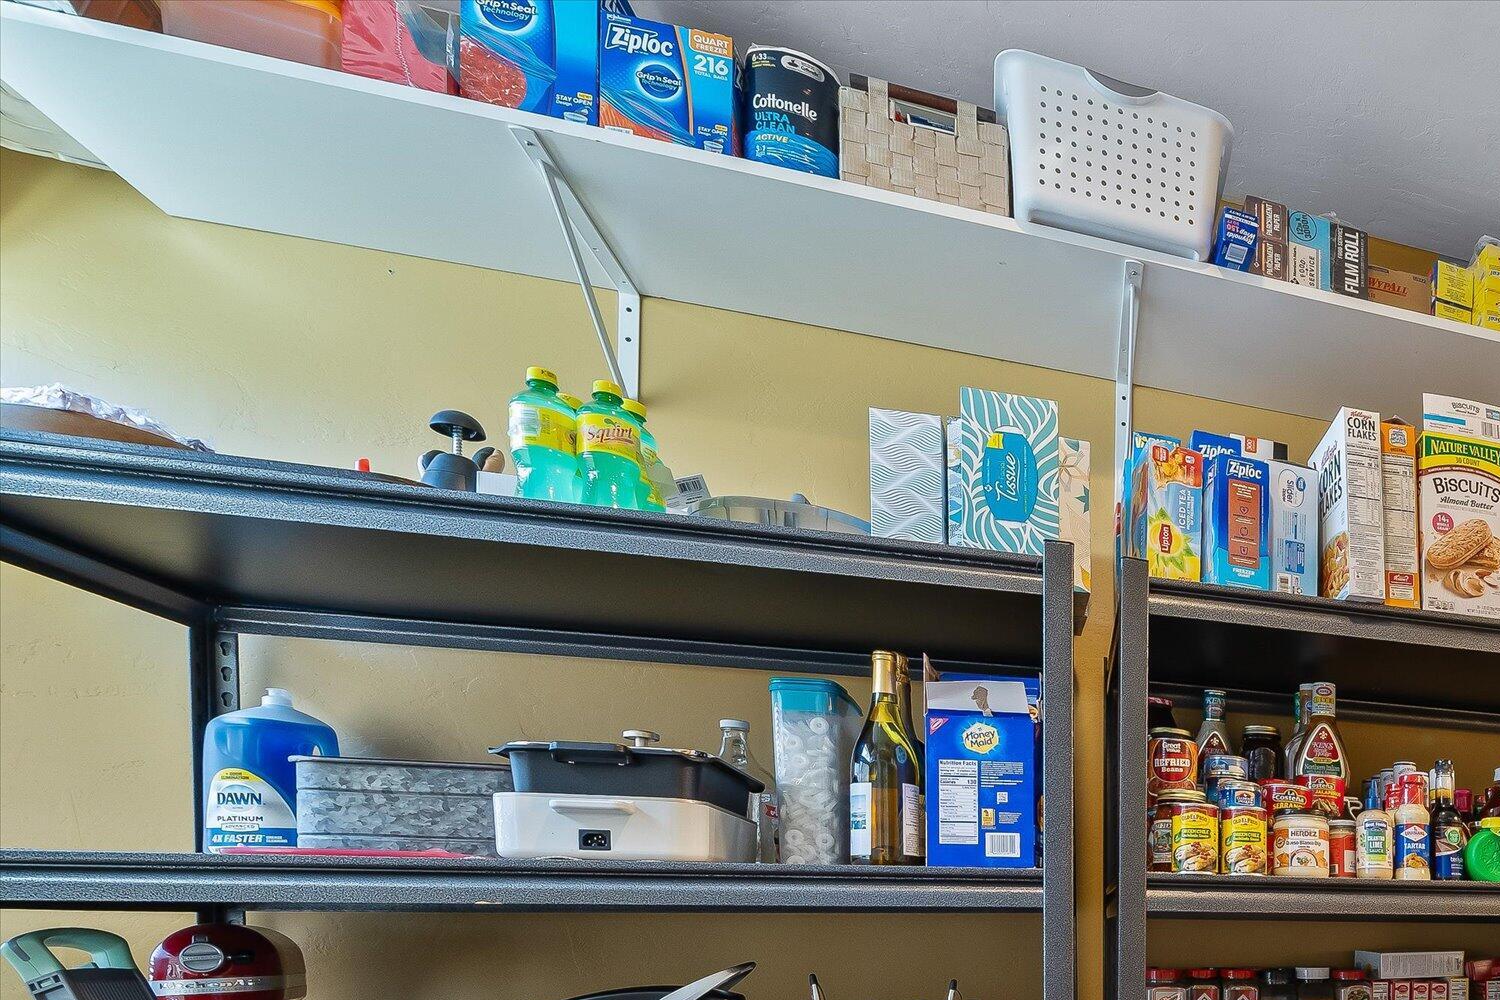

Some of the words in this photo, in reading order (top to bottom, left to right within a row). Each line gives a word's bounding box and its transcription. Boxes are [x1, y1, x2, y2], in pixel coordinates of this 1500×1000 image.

[612, 26, 673, 57] Ziploc
[694, 35, 729, 49] QUART
[696, 43, 728, 55] FREEZER
[694, 54, 729, 76] 216
[753, 93, 818, 121] Cottonelle
[754, 112, 790, 124] ULTRA
[755, 121, 796, 134] CLEAN
[1345, 231, 1360, 260] ROLL
[1345, 263, 1359, 294] FILM
[1346, 417, 1376, 432] CORN
[586, 425, 635, 445] Squirt
[1348, 428, 1377, 441] FLAKES
[1431, 439, 1469, 456] NATURE
[1229, 461, 1262, 479] Ziploc
[1319, 450, 1341, 498] CORN
[1286, 480, 1294, 503] Slider
[1440, 496, 1469, 507] Almond
[1161, 526, 1170, 551] Lipton
[965, 730, 995, 741] Honey
[970, 738, 992, 748] Maid
[217, 792, 262, 806] DAWN
[224, 834, 263, 843] FASTER
